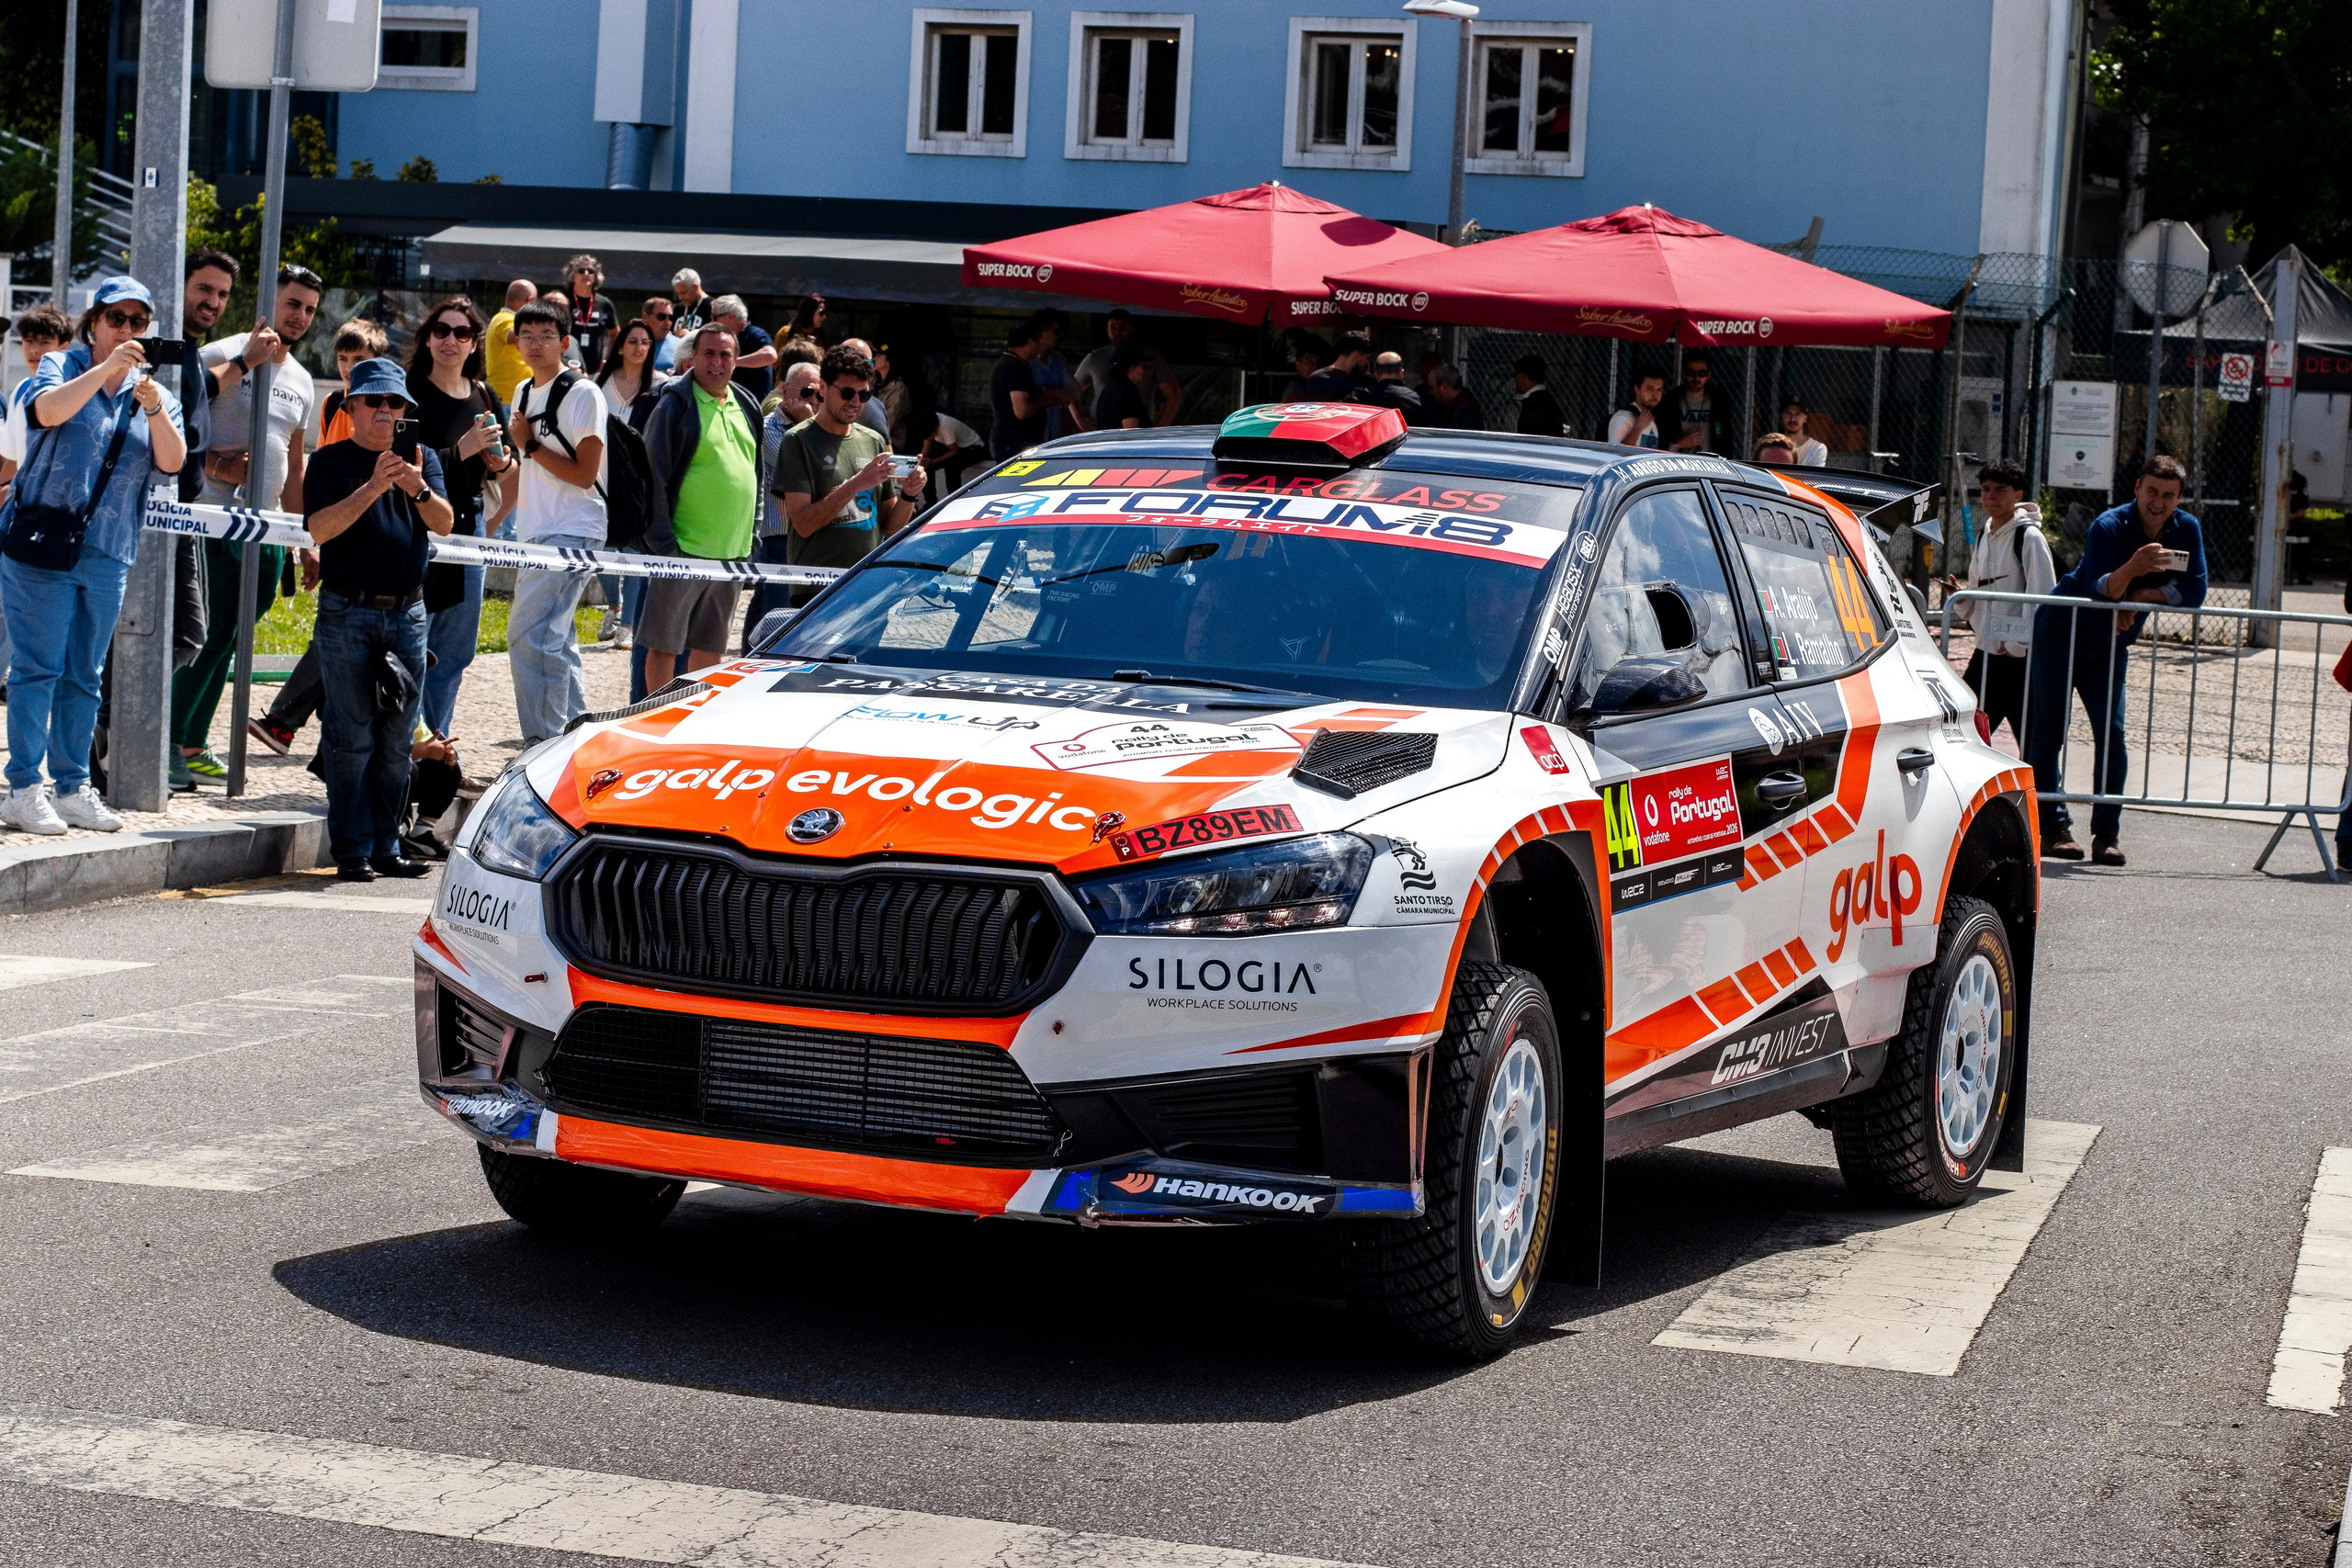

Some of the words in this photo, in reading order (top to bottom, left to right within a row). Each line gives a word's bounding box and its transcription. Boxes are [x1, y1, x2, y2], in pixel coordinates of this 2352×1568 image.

[978, 263, 1005, 276] SUPER
[1006, 264, 1035, 277] BOCK
[1180, 283, 1210, 299] Sabor
[1335, 289, 1374, 305] SUPER
[1376, 292, 1408, 307] BOCK
[1291, 301, 1321, 315] SUPER
[1576, 305, 1608, 321] Sabor
[1697, 321, 1726, 334] SUPER
[1725, 321, 1755, 334] BOCK
[2305, 356, 2331, 373] DE
[1009, 465, 1028, 474] 2
[1627, 460, 1663, 478] ABRIGO
[1664, 458, 1679, 472] DA
[1676, 458, 1733, 475] MONTANHA
[1206, 472, 1508, 513] CARGLASS
[146, 515, 209, 534] UNICIPAL
[1052, 491, 1514, 547] FORUM8
[1126, 514, 1321, 534] フォーラムエイト
[478, 544, 527, 558] POLÍCIA
[1579, 535, 1596, 560] BELL
[482, 556, 550, 570] MUNICIPAL
[643, 560, 691, 571] POLÍCIA
[1060, 591, 1080, 599] RACING
[1091, 581, 1117, 593] OMP
[1769, 586, 1785, 618] A.
[1781, 586, 1818, 627] Araújo
[1827, 555, 1883, 651] 44
[1543, 626, 1564, 664] OMP
[1781, 632, 1799, 665] L.
[1794, 632, 1845, 666] Ramalho
[936, 673, 1048, 687] CASA
[1055, 682, 1123, 695] DA
[818, 678, 1192, 715] PASSARELLA
[1130, 724, 1170, 733] 44
[1112, 735, 1159, 744] rally
[1115, 733, 1259, 751] Portugal
[1057, 749, 1107, 760] vodafone
[1540, 753, 1566, 771] acp
[614, 759, 776, 801] galp
[786, 768, 1102, 832] evologic
[1668, 786, 1684, 800] rally
[1683, 785, 1692, 796] de
[1670, 789, 1735, 825] Portugal
[1134, 807, 1295, 853] BZ89EM
[1602, 783, 1640, 869] 44
[1726, 822, 1738, 835] 2026
[1644, 829, 1670, 847] vodafone
[1121, 847, 1131, 855] P
[1394, 895, 1426, 905] SANTO
[1426, 896, 1453, 906] TIRSO
[1826, 829, 1923, 963] galp
[447, 884, 510, 930] SILOGIA
[1396, 906, 1423, 914] CÂMARA
[1423, 907, 1455, 915] MUNICIPAL
[472, 929, 500, 945] SOLUTIONS
[1129, 956, 1317, 995] SILOGIA
[1148, 998, 1226, 1010] WORKPLACE
[1227, 999, 1298, 1012] SOLUTIONS
